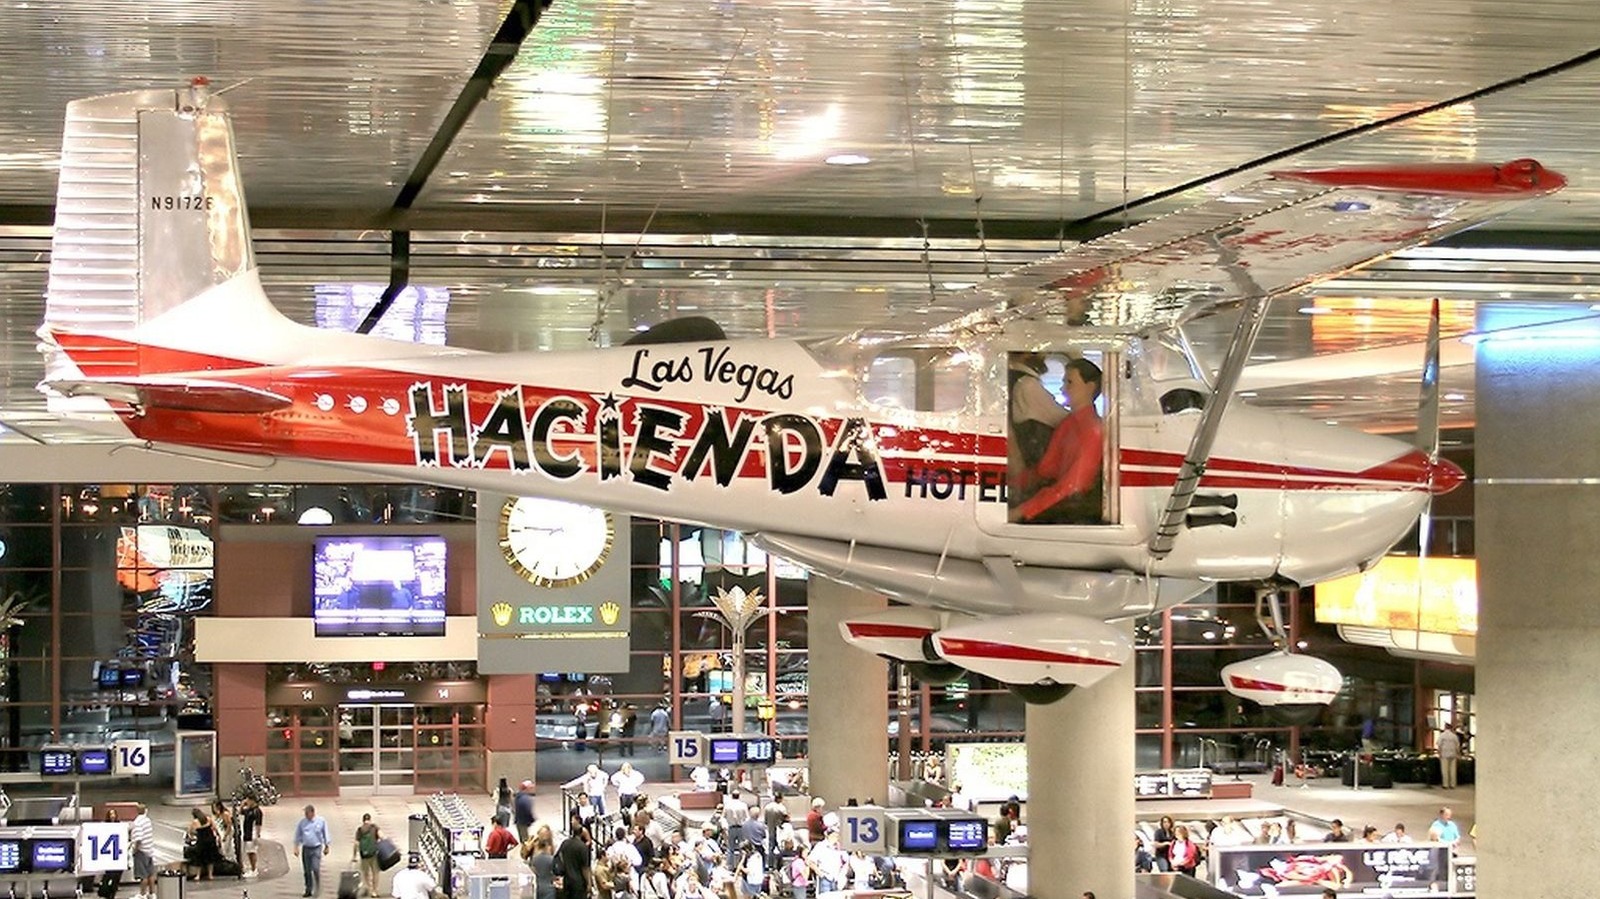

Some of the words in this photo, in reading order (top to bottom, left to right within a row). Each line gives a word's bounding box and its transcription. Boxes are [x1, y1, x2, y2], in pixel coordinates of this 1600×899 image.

[621, 349, 693, 392] Las
[698, 346, 795, 403] Vegas
[407, 381, 889, 501] HACIENDA
[905, 465, 1008, 503] HOTEL
[519, 605, 593, 624] ROLEX
[120, 747, 146, 767] 16
[674, 738, 698, 758] 15
[845, 816, 880, 844] 13
[87, 834, 123, 861] 14
[1363, 850, 1386, 866] LE
